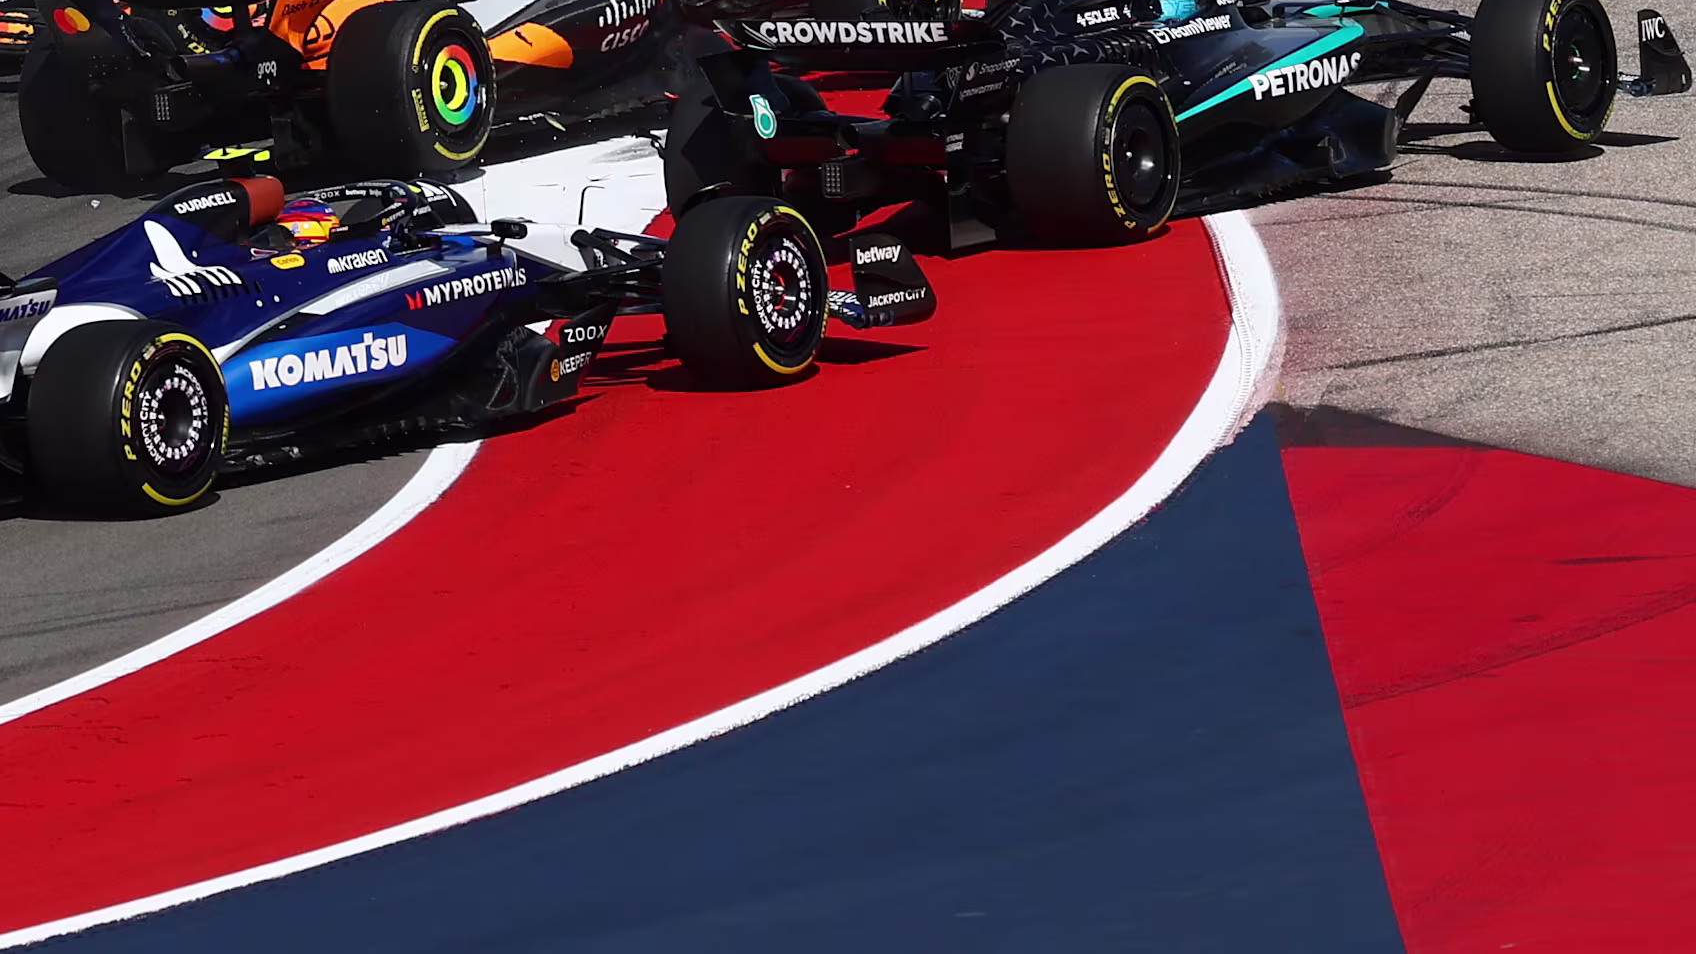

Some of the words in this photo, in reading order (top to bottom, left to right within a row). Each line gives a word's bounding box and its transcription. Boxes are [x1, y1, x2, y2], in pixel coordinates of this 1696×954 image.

[759, 21, 949, 44] CROWDSTRIKE
[1169, 14, 1232, 40] TeamViewer
[1640, 16, 1666, 42] IWC
[257, 59, 277, 79] groq
[1248, 51, 1362, 101] PETRONAS
[1103, 152, 1127, 218] ZERO
[173, 191, 236, 215] DURACELL
[341, 248, 389, 270] kraken
[736, 221, 759, 290] ZERO
[856, 244, 902, 265] betway
[867, 289, 905, 309] JACKPOT
[905, 287, 926, 302] CITY
[563, 325, 608, 344] ZOOX
[249, 332, 407, 391] KOMATSU
[558, 351, 592, 377] KEEPER
[120, 360, 143, 436] ZERO
